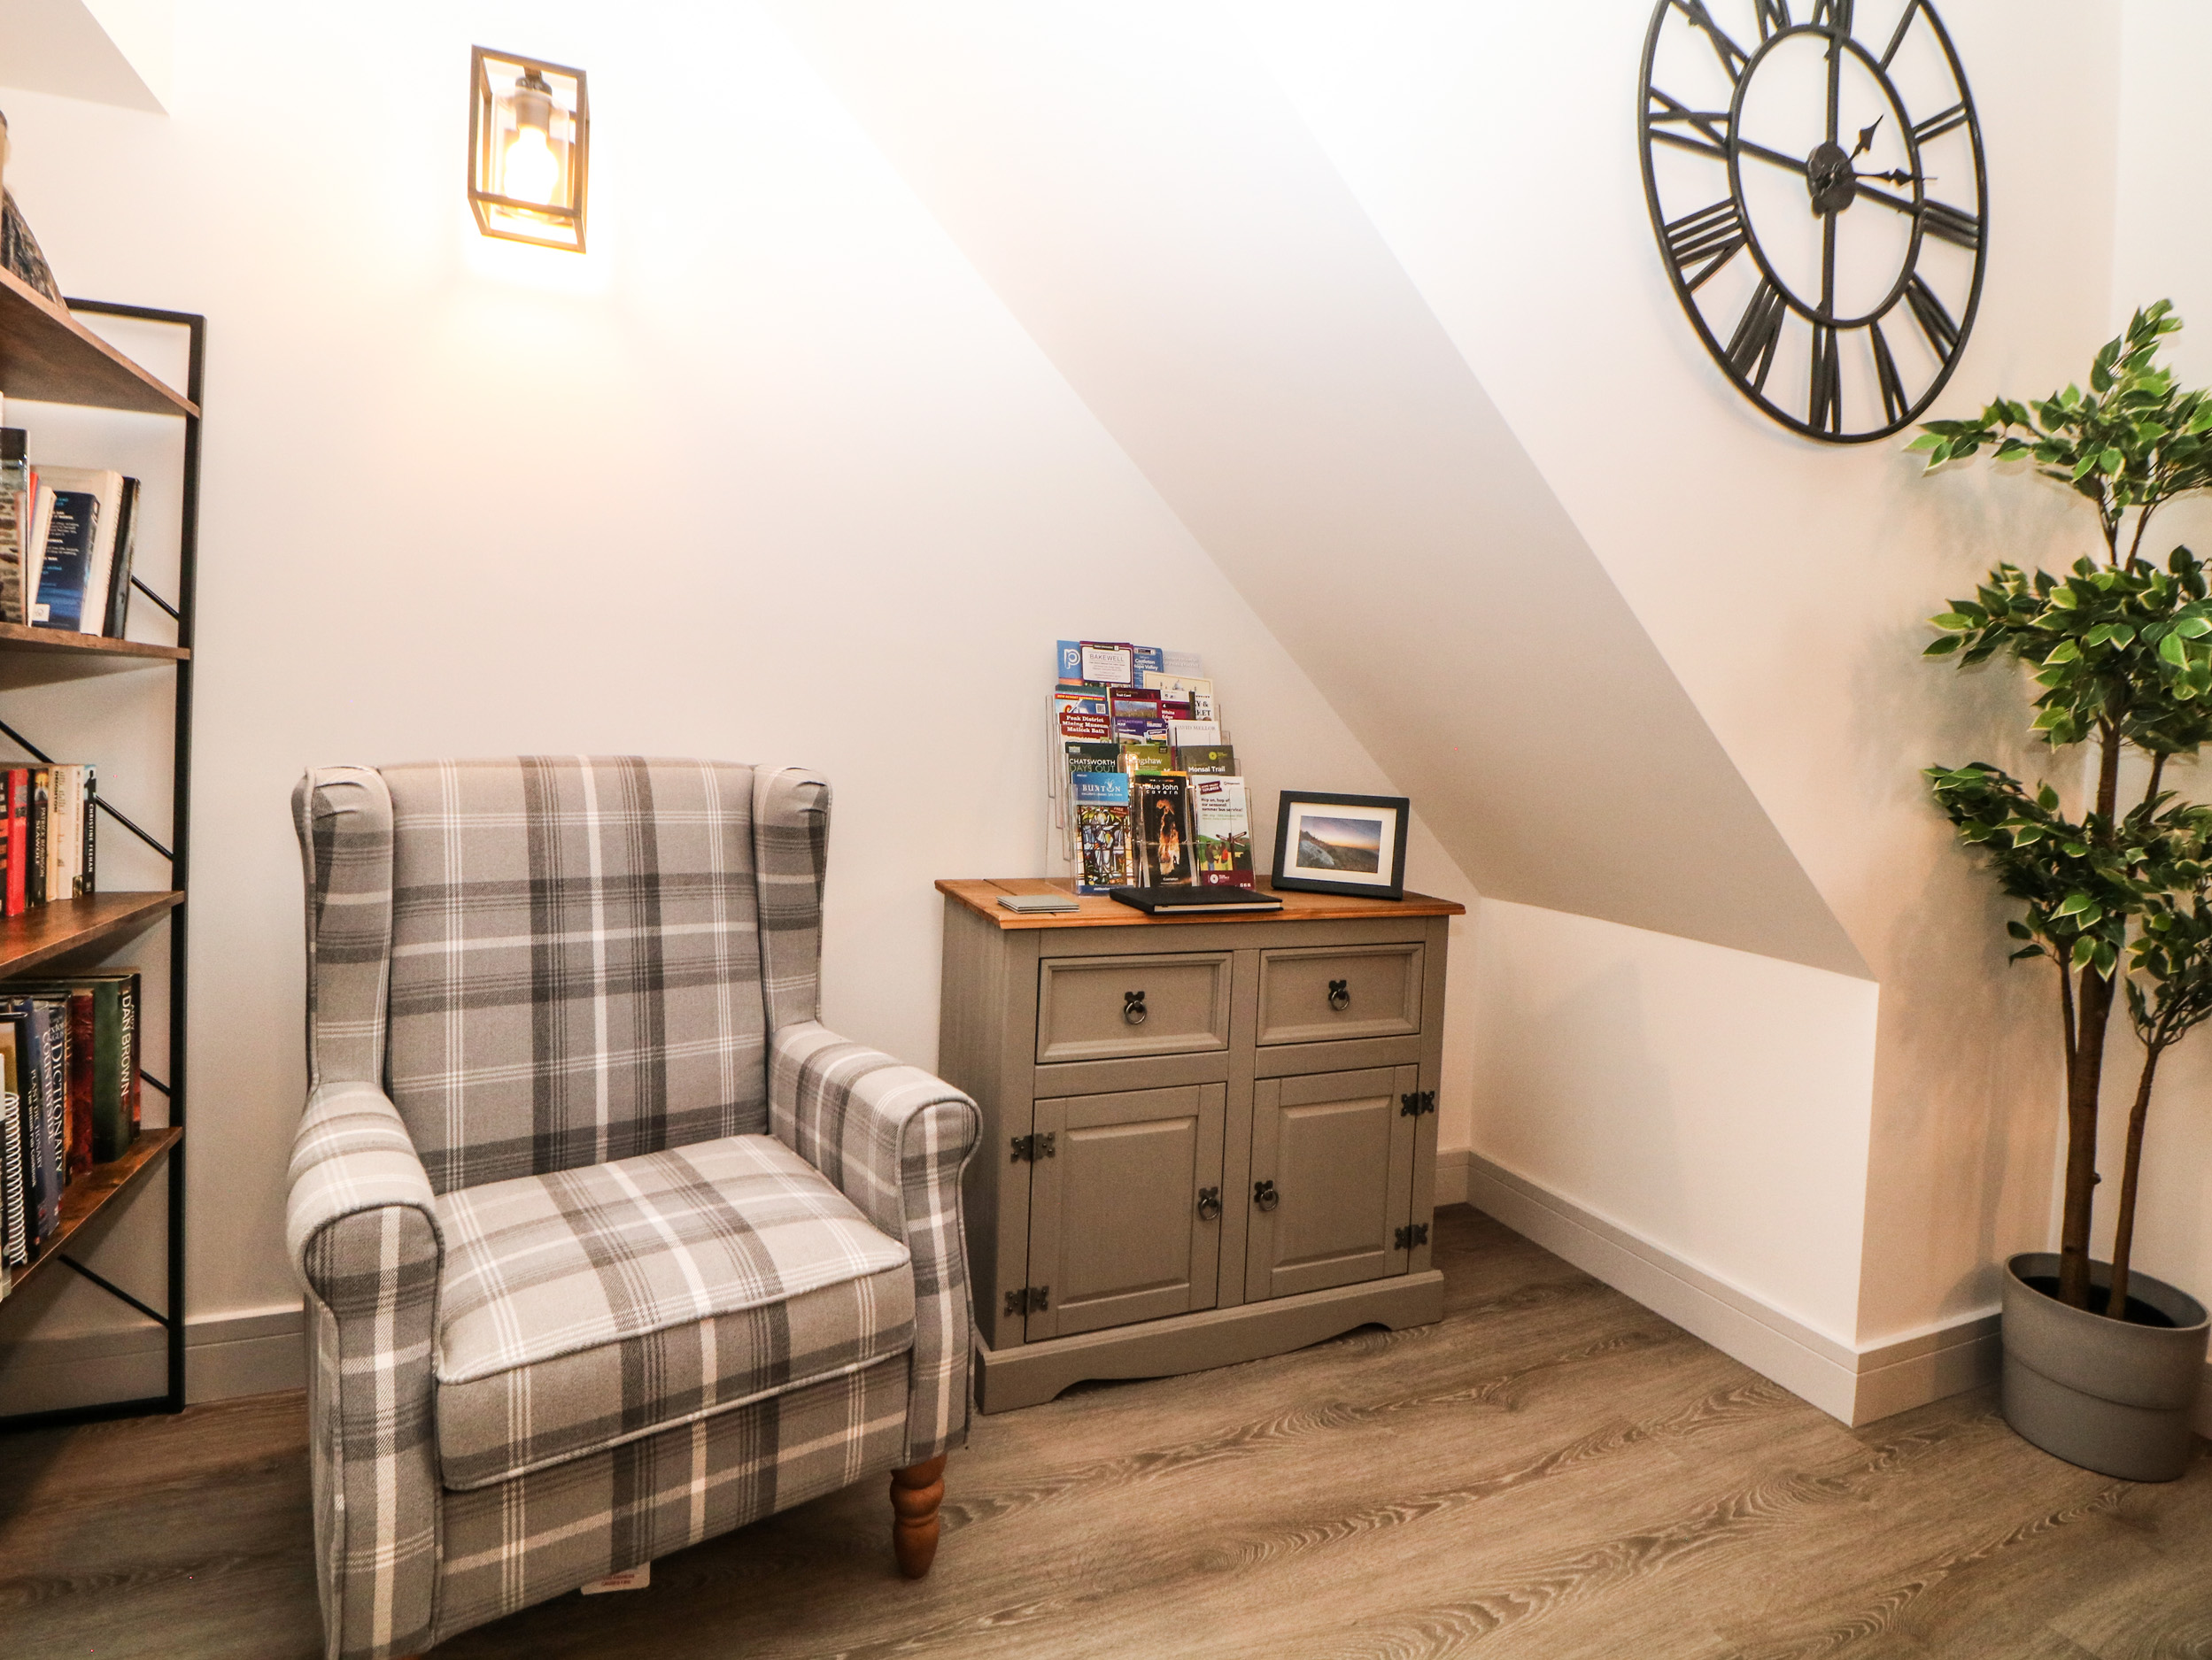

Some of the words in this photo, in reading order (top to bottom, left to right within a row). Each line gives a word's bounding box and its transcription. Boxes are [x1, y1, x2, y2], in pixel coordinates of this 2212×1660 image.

[1089, 653, 1125, 662] BAKEWELL
[1069, 764, 1093, 773] DAYS
[1082, 784, 1121, 792] BUXTON
[121, 995, 132, 1031] DAN
[120, 1032, 132, 1098] BROWN
[30, 1069, 39, 1103] PLANT
[51, 1040, 63, 1172] DICTIONARY
[33, 1105, 43, 1169] DICTIONARY
